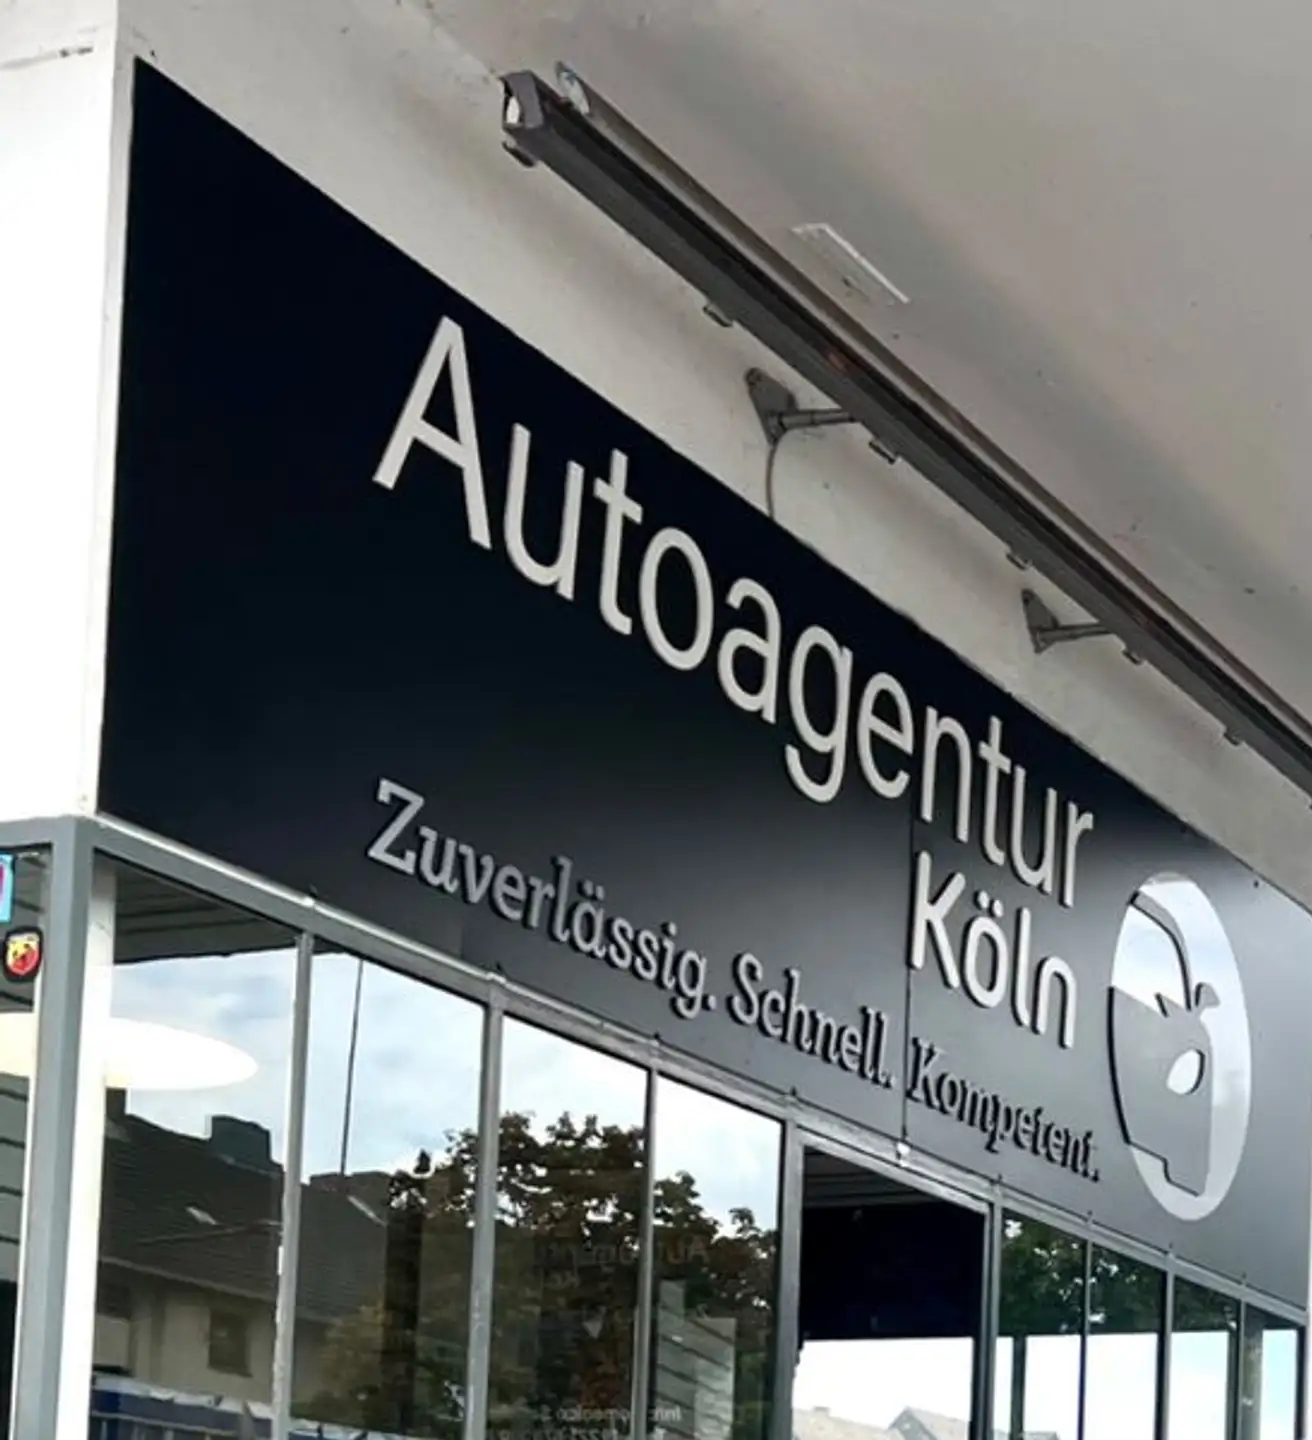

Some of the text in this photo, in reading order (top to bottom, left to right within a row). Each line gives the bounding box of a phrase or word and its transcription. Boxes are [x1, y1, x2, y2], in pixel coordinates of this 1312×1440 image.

[372, 314, 1094, 909] Autoagentur
[367, 779, 1100, 1184] Zuverlässig. Schnell. Kompetent.
[909, 848, 1076, 1050] Köln
